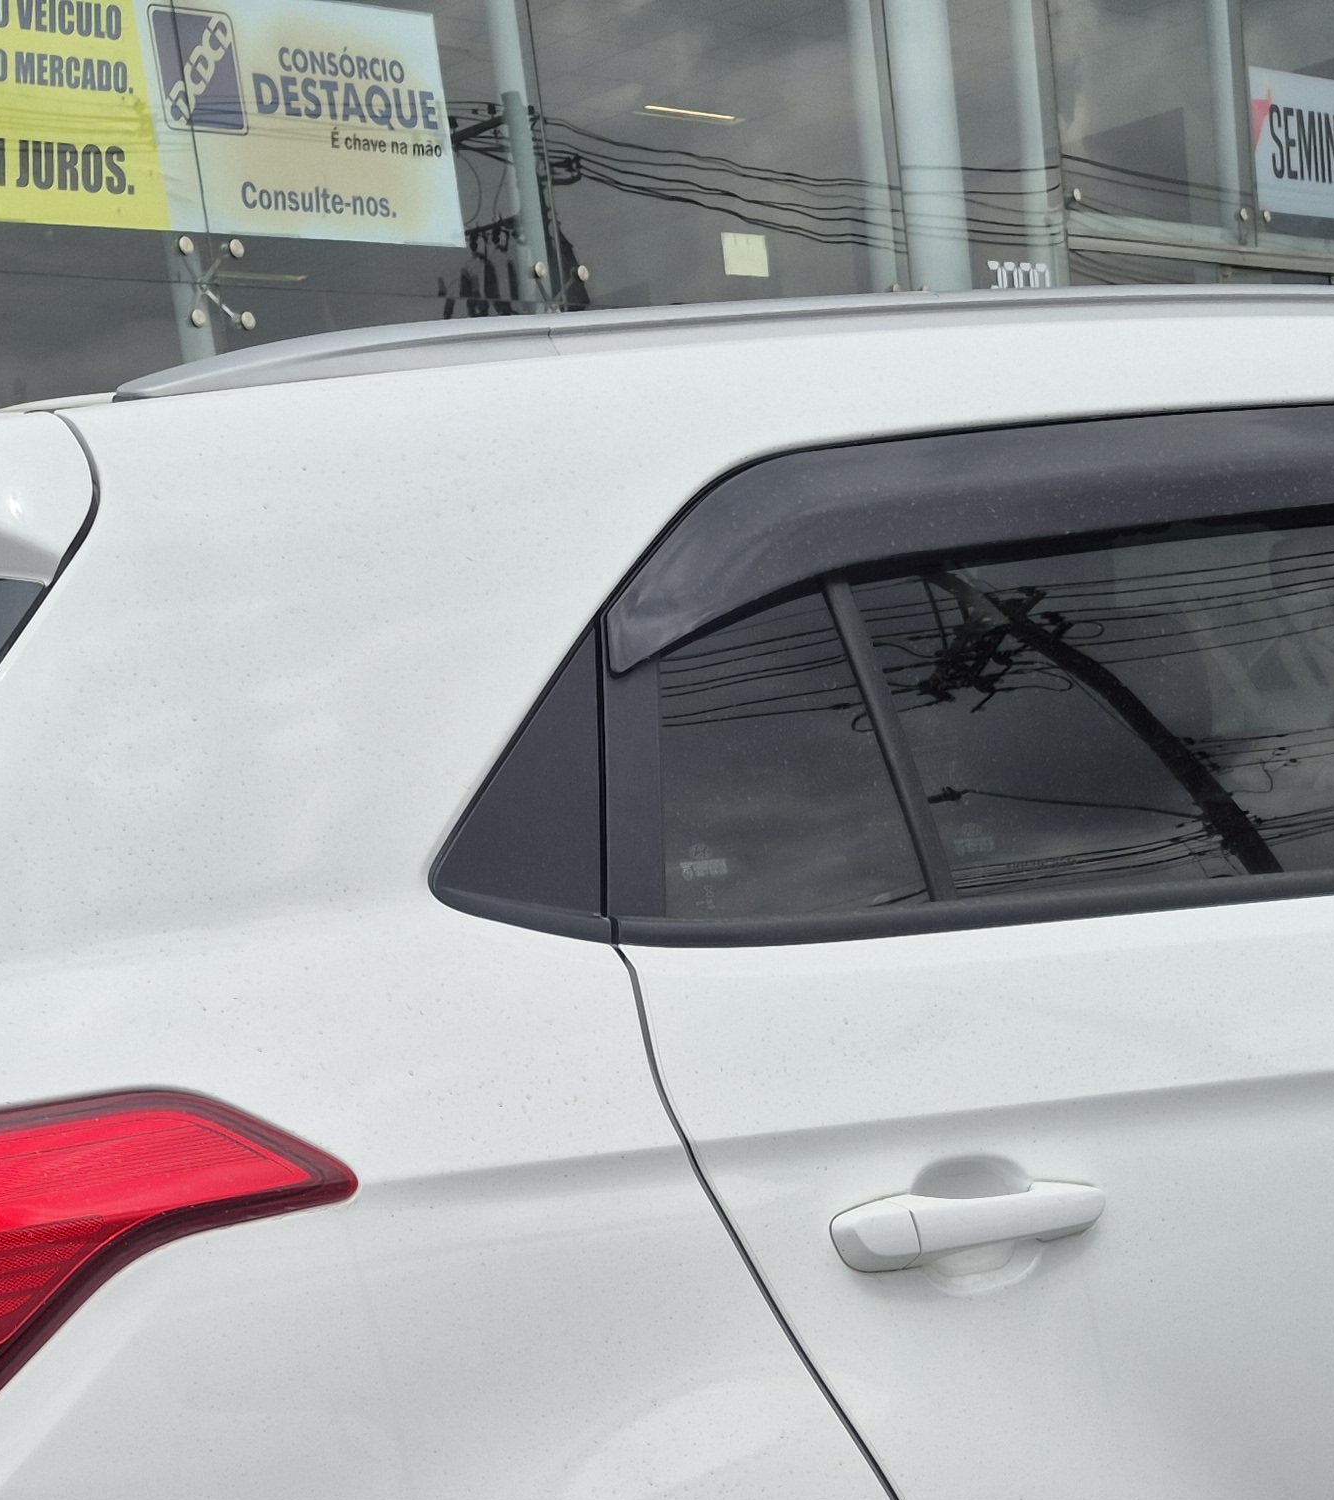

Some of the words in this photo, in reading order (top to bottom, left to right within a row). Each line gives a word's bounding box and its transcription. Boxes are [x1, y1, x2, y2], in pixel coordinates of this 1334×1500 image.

[15, 51, 134, 94] MERCADO.
[278, 46, 405, 84] CONSÓRCIO
[252, 73, 439, 130] DESTAQUE
[330, 127, 340, 149] É
[344, 132, 387, 153] chave
[391, 141, 408, 155] na
[412, 140, 443, 158] mão
[16, 139, 135, 195] JUROS.
[241, 181, 397, 218] Consulte-nos.
